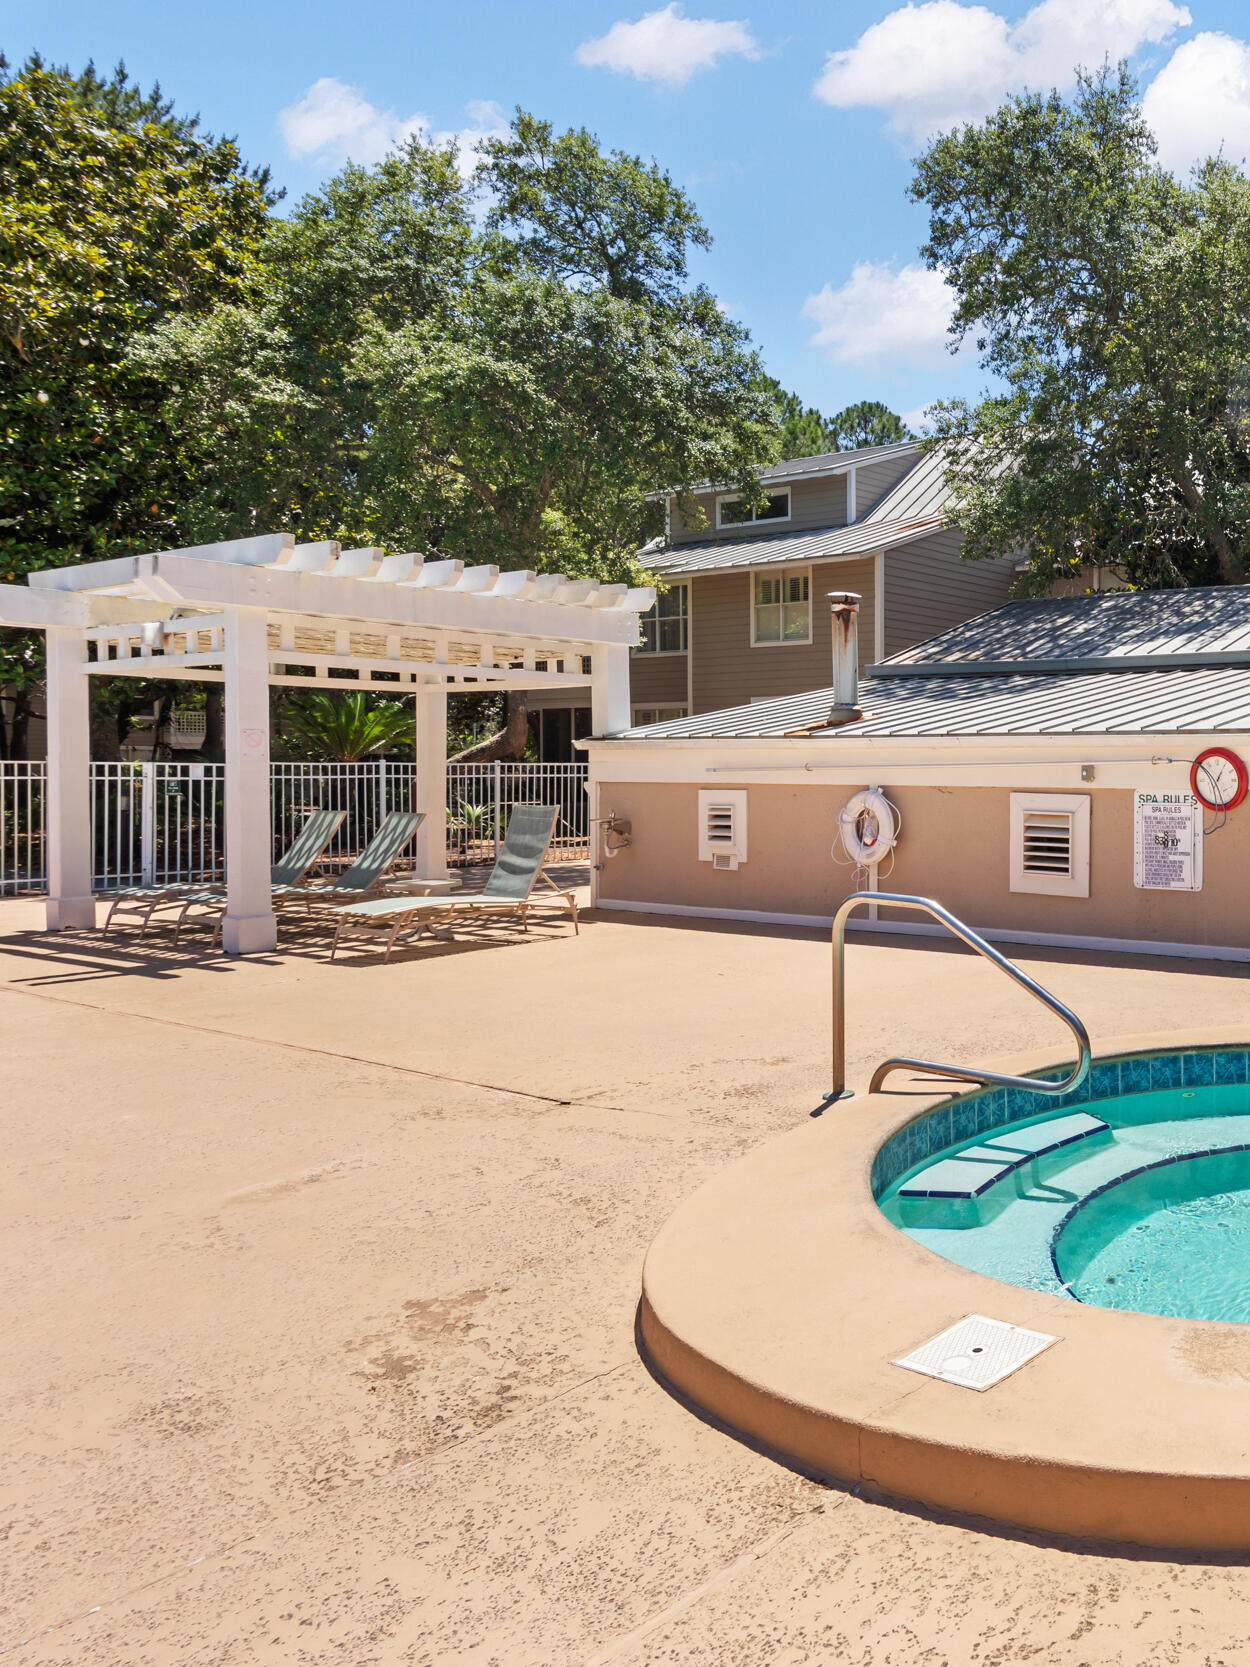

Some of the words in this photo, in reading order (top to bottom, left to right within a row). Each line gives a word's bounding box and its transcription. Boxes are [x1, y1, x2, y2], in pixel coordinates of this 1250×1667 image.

[1139, 794, 1158, 803] SPA
[1163, 794, 1198, 805] RULES
[1163, 806, 1182, 814] RULES
